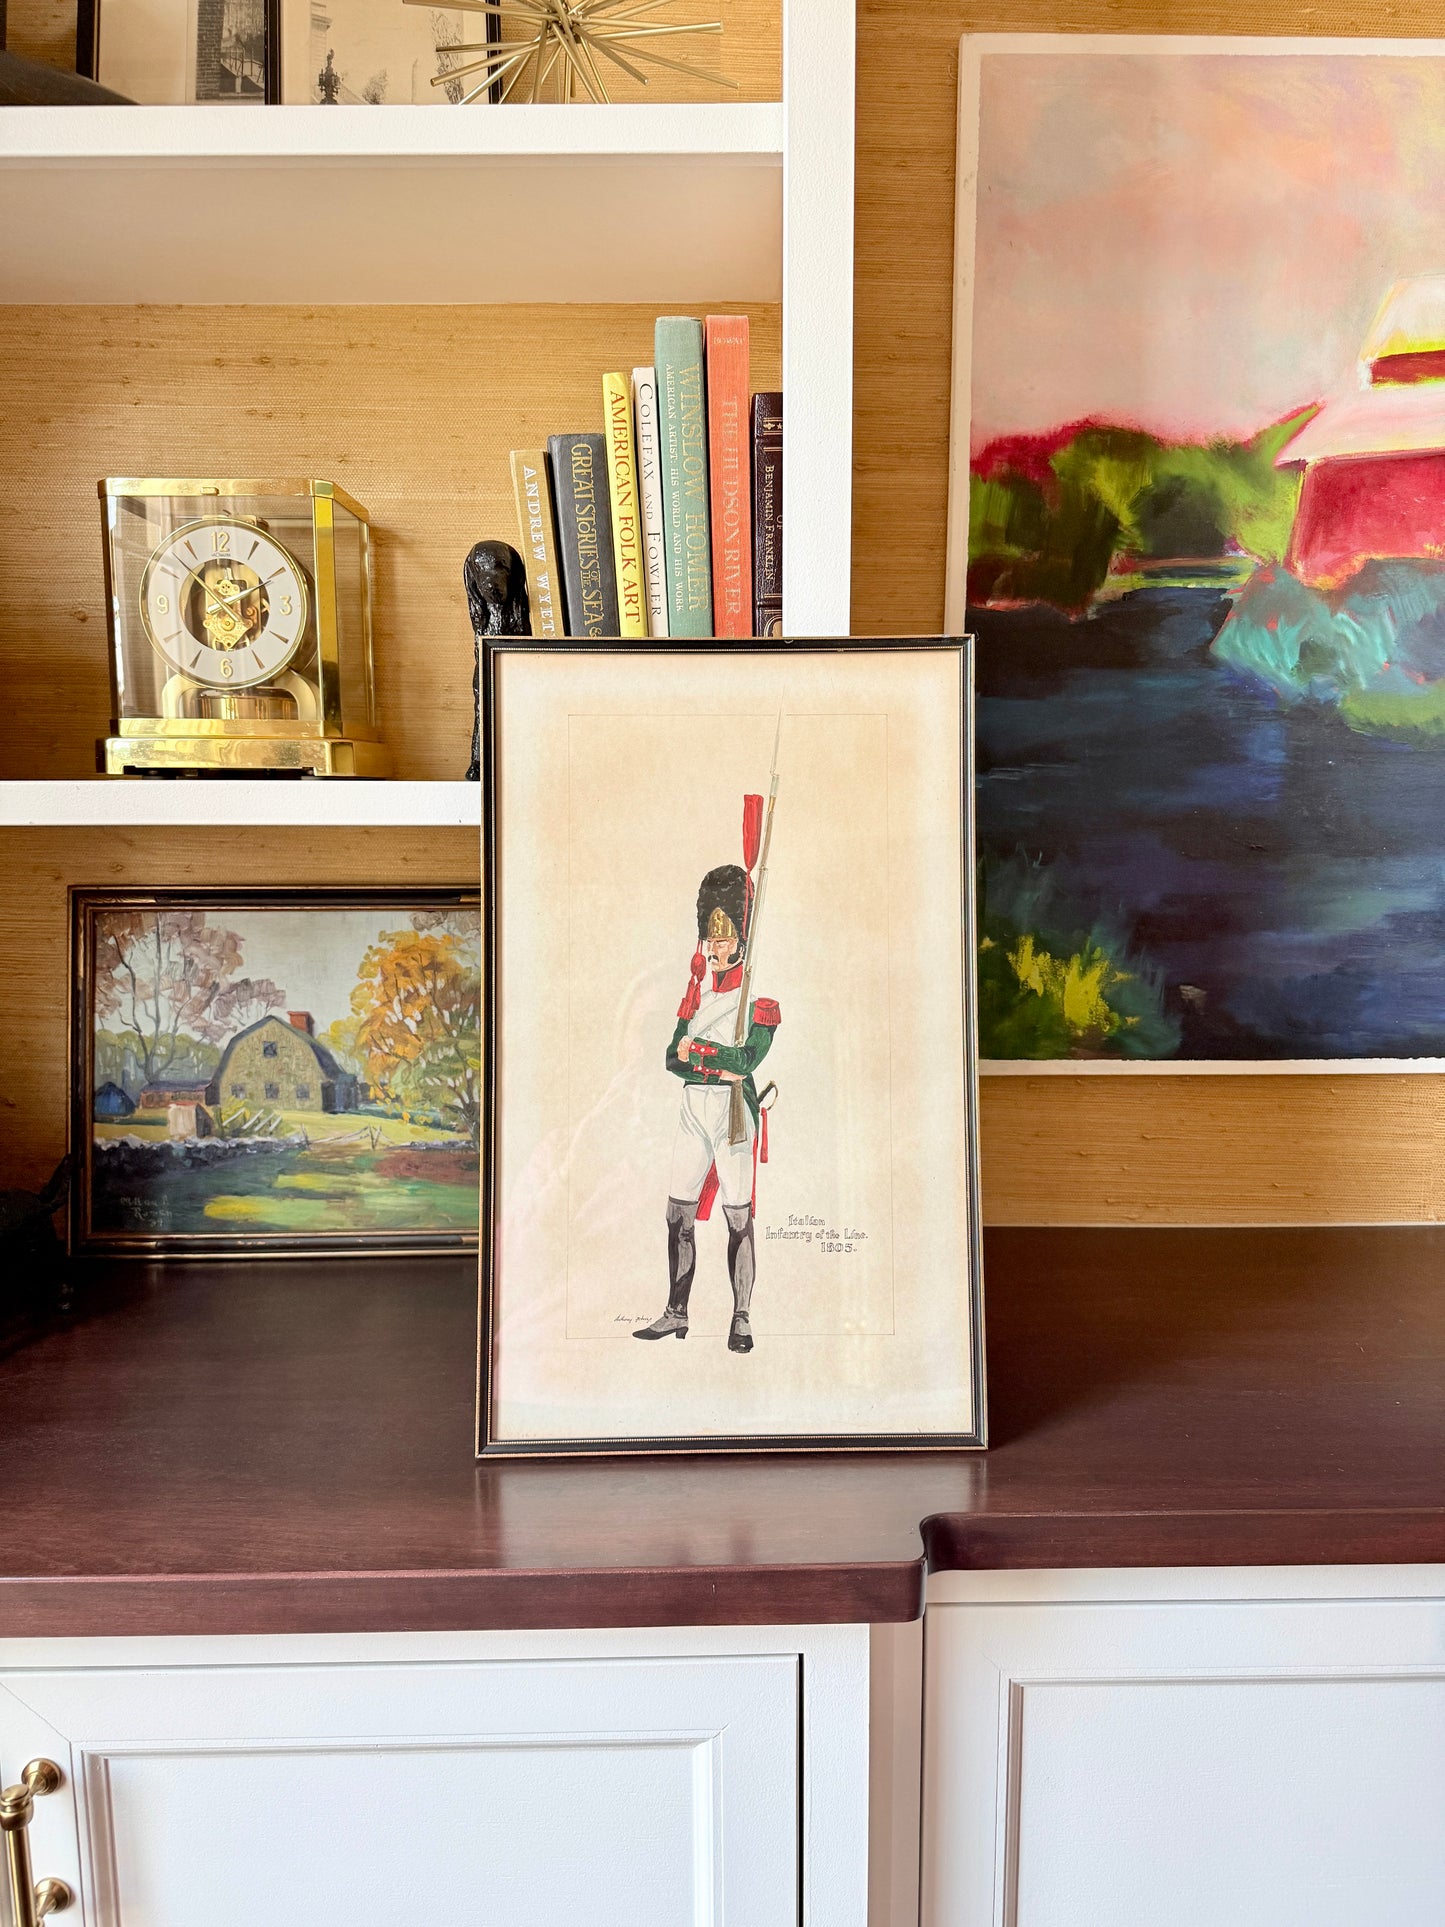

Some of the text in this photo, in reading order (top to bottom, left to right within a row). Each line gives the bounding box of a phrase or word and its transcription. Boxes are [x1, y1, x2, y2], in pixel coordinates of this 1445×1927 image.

[722, 400, 739, 439] THE
[570, 443, 596, 503] GREAT
[665, 363, 685, 613] AMERICAN ARTIST: HIS WORLD AND HIS WORK
[679, 363, 709, 612] WINSLOW HOMER
[610, 390, 641, 623] AMERICAN FOLK ART
[645, 493, 654, 520] AND
[764, 465, 776, 582] BENJAMIN FRANKLIN
[211, 531, 231, 552] 12
[523, 465, 556, 637] ANDREW WYET
[575, 503, 600, 571] STORIES
[724, 548, 741, 614] RIVER
[156, 595, 169, 614] 9
[279, 596, 292, 615] 3
[582, 588, 605, 627] SEA
[220, 658, 233, 678] 6
[765, 1226, 869, 1243] Infantry of the Line.
[788, 1214, 826, 1226] Italian
